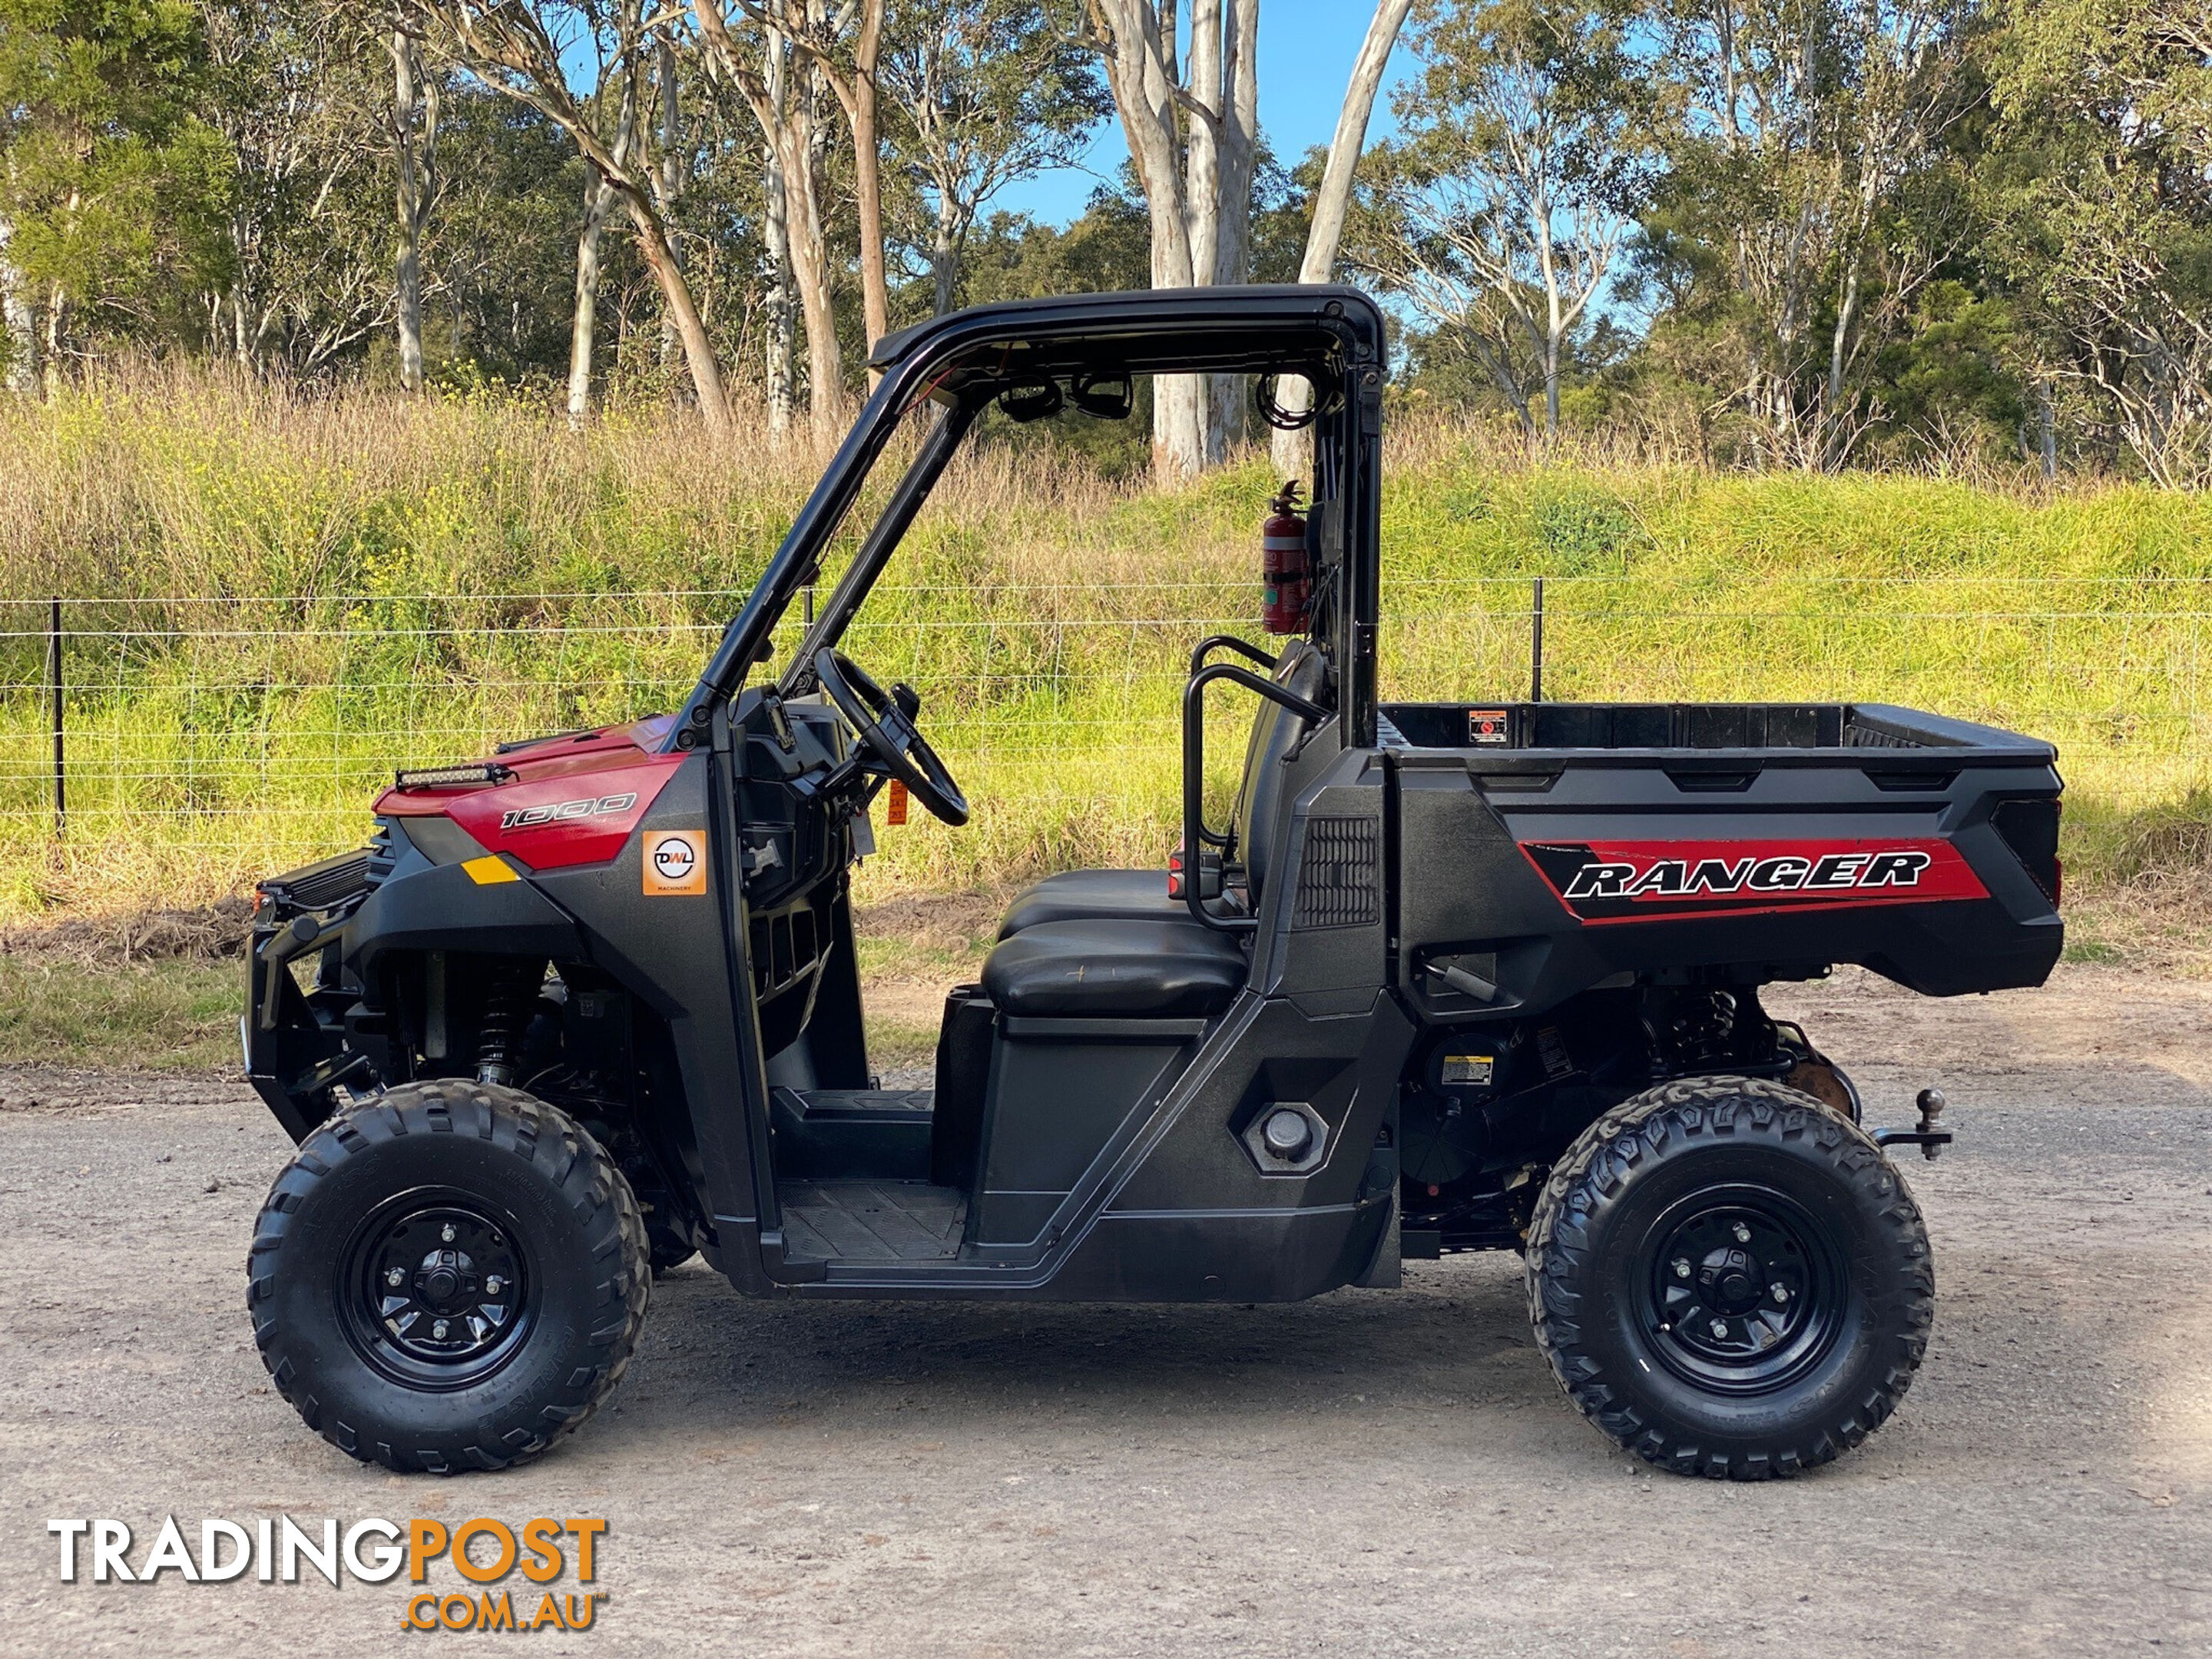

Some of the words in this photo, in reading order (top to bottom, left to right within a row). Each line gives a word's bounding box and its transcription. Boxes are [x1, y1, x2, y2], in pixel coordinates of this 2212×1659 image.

[500, 792, 637, 830] 1000
[657, 851, 694, 864] DWL
[1564, 851, 1932, 899] RANGER
